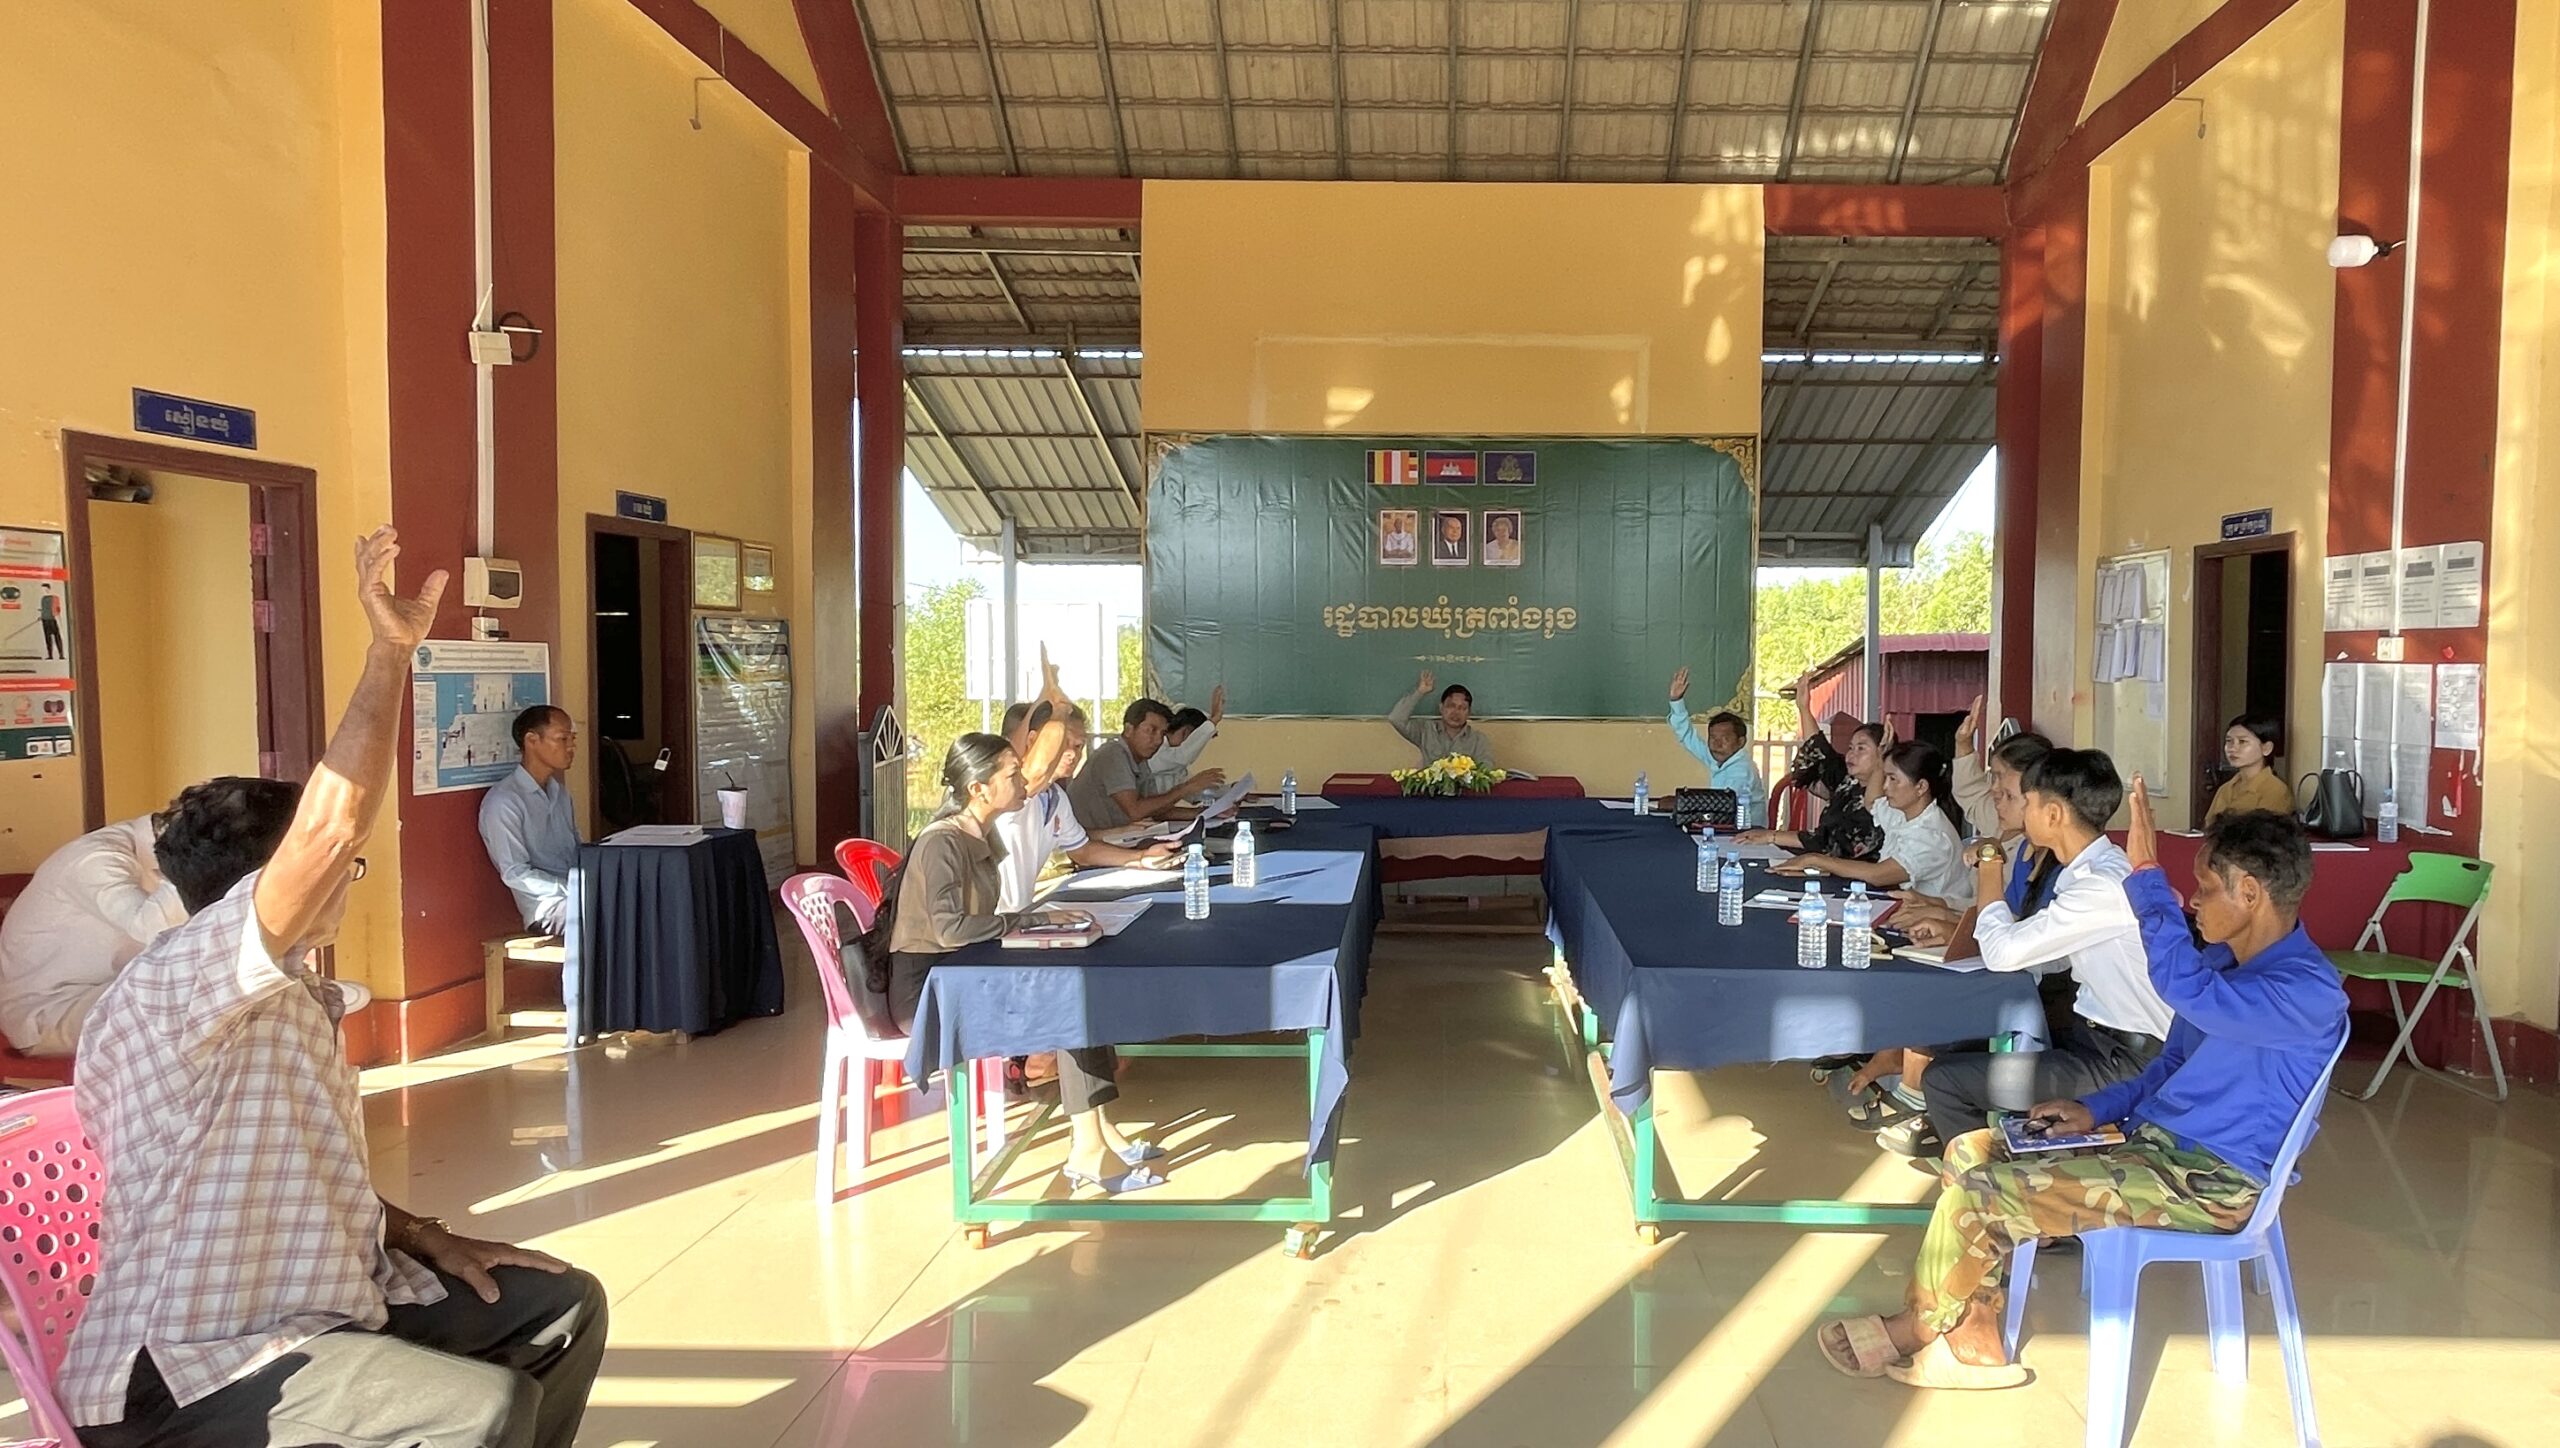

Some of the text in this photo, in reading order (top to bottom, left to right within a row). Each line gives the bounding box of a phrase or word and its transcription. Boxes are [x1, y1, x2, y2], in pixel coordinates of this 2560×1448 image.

[1323, 595, 1577, 638] រដ្ឋបាលឃុំត្រពាំងរូង
